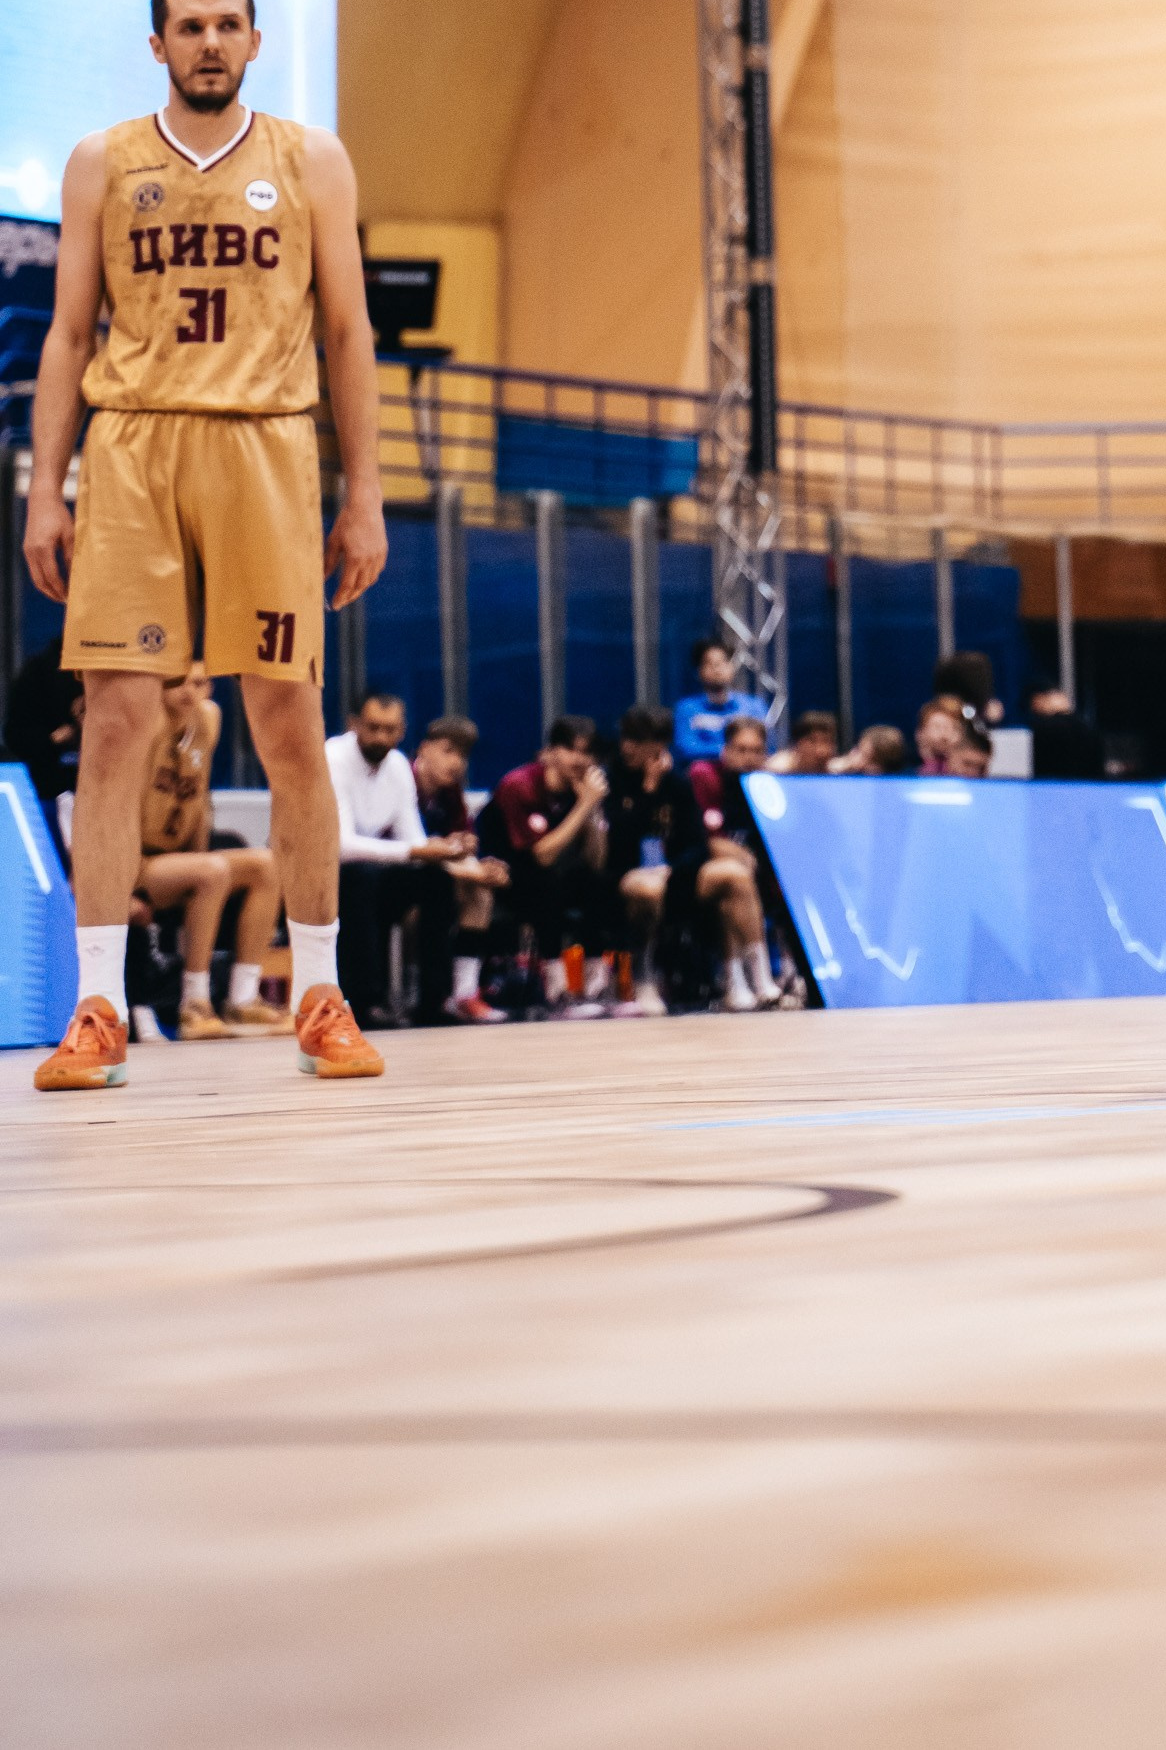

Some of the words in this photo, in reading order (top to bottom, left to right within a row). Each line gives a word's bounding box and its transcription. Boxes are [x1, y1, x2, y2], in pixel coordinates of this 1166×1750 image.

[129, 223, 280, 275] ЦИВС
[176, 287, 226, 343] 31
[256, 610, 295, 663] 31
